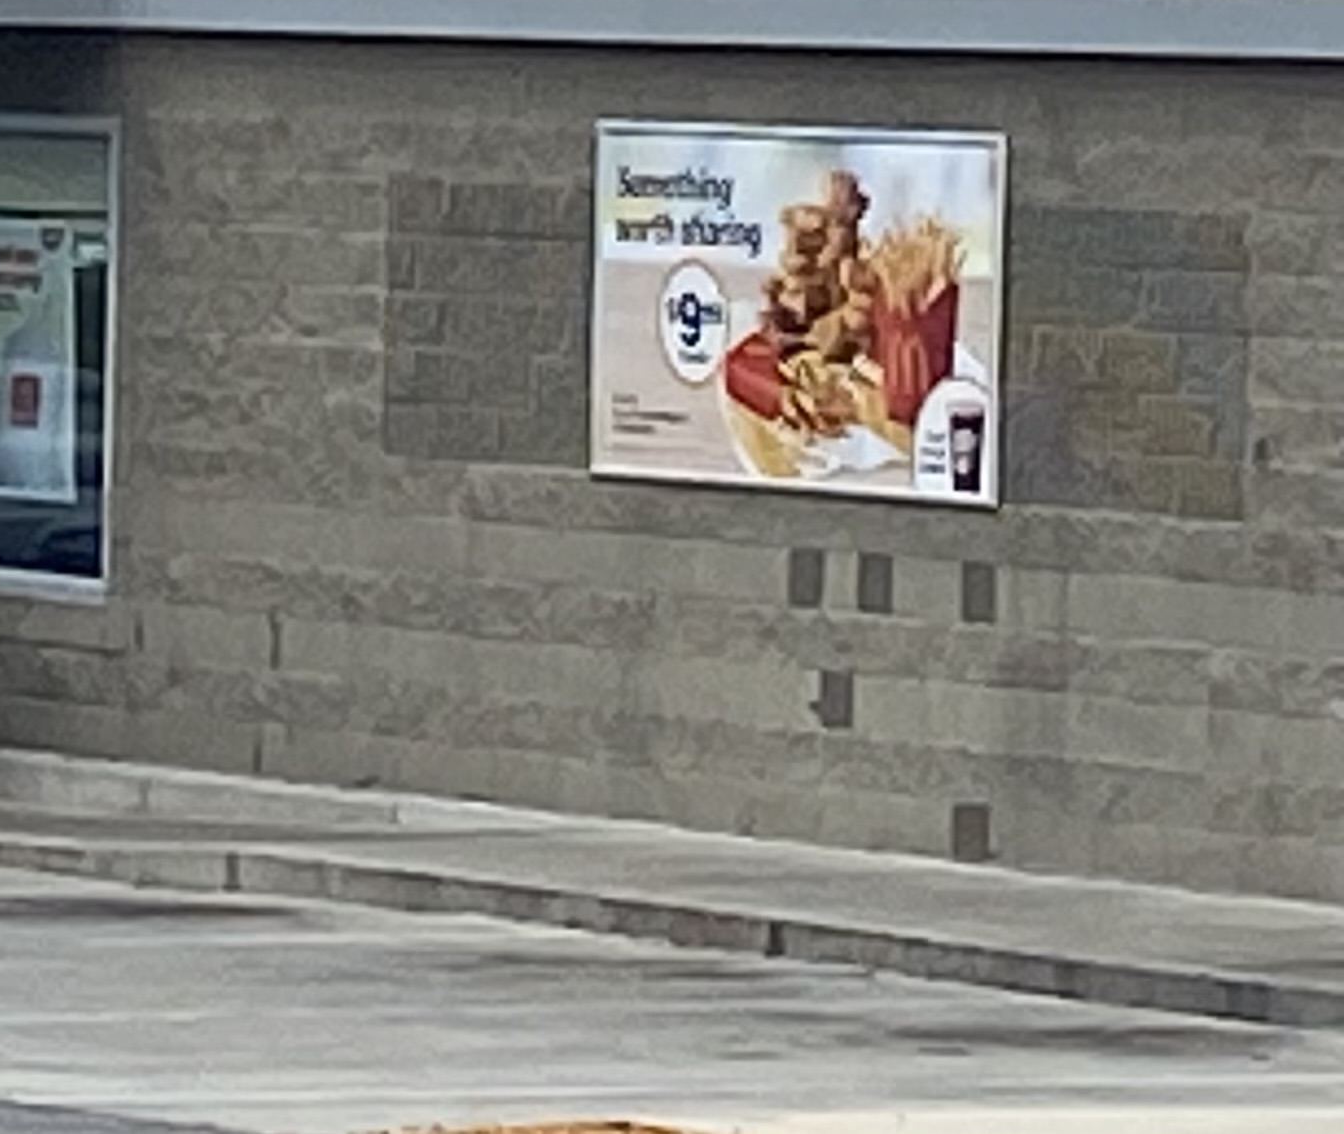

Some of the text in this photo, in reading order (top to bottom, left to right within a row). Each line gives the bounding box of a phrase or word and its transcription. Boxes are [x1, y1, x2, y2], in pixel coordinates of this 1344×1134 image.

[617, 165, 734, 210] Something
[616, 213, 762, 258] worth sharing
